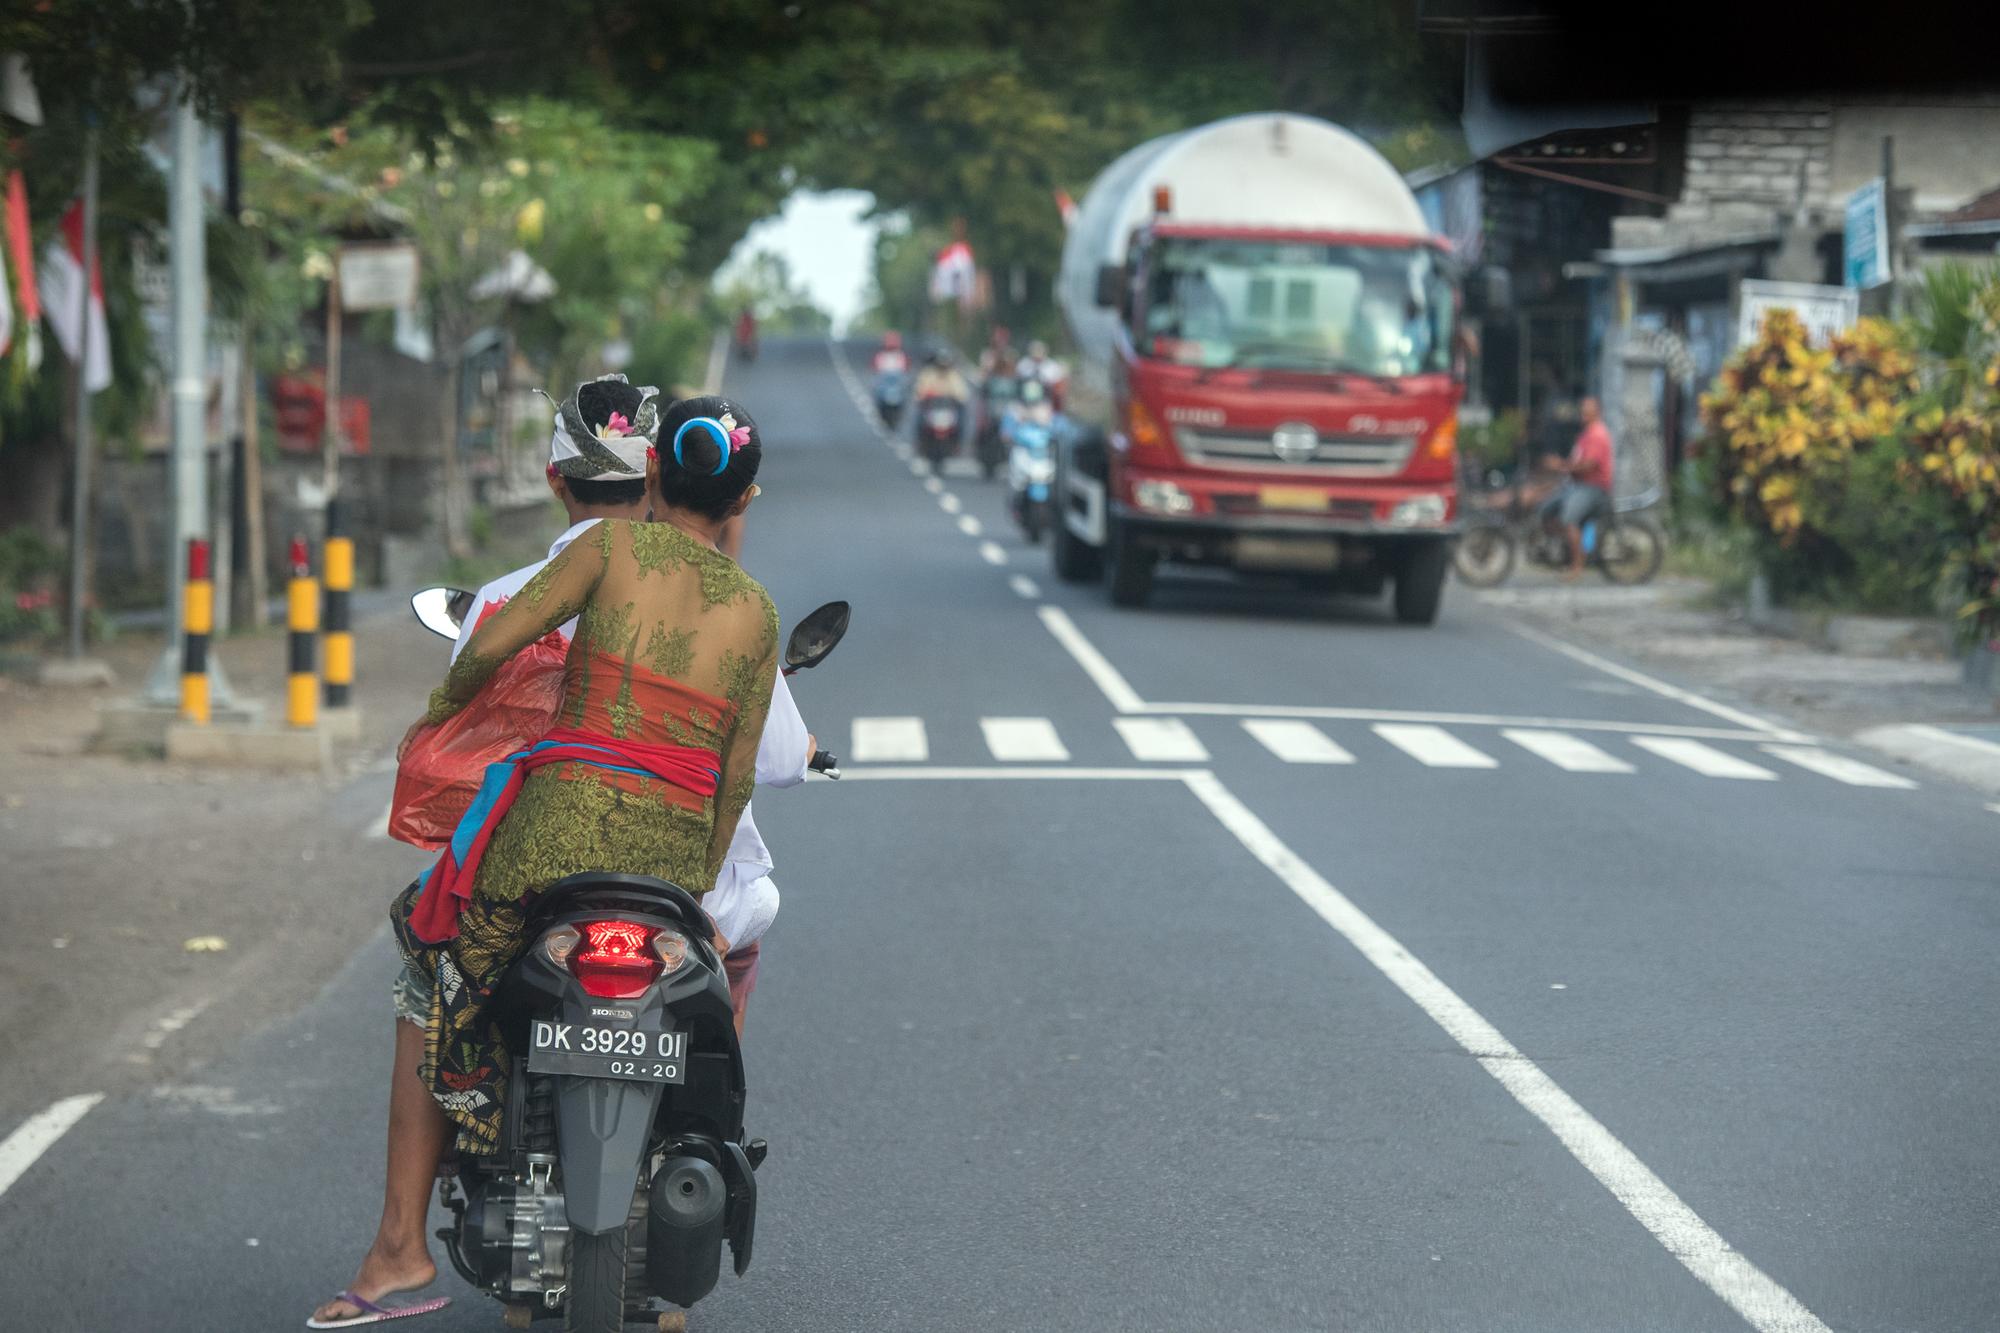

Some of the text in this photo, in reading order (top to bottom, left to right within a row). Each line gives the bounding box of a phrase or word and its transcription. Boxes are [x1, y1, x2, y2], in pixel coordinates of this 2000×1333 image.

[592, 1008, 633, 1018] HONDA
[536, 1023, 572, 1050] DK
[581, 1028, 646, 1056] 3929
